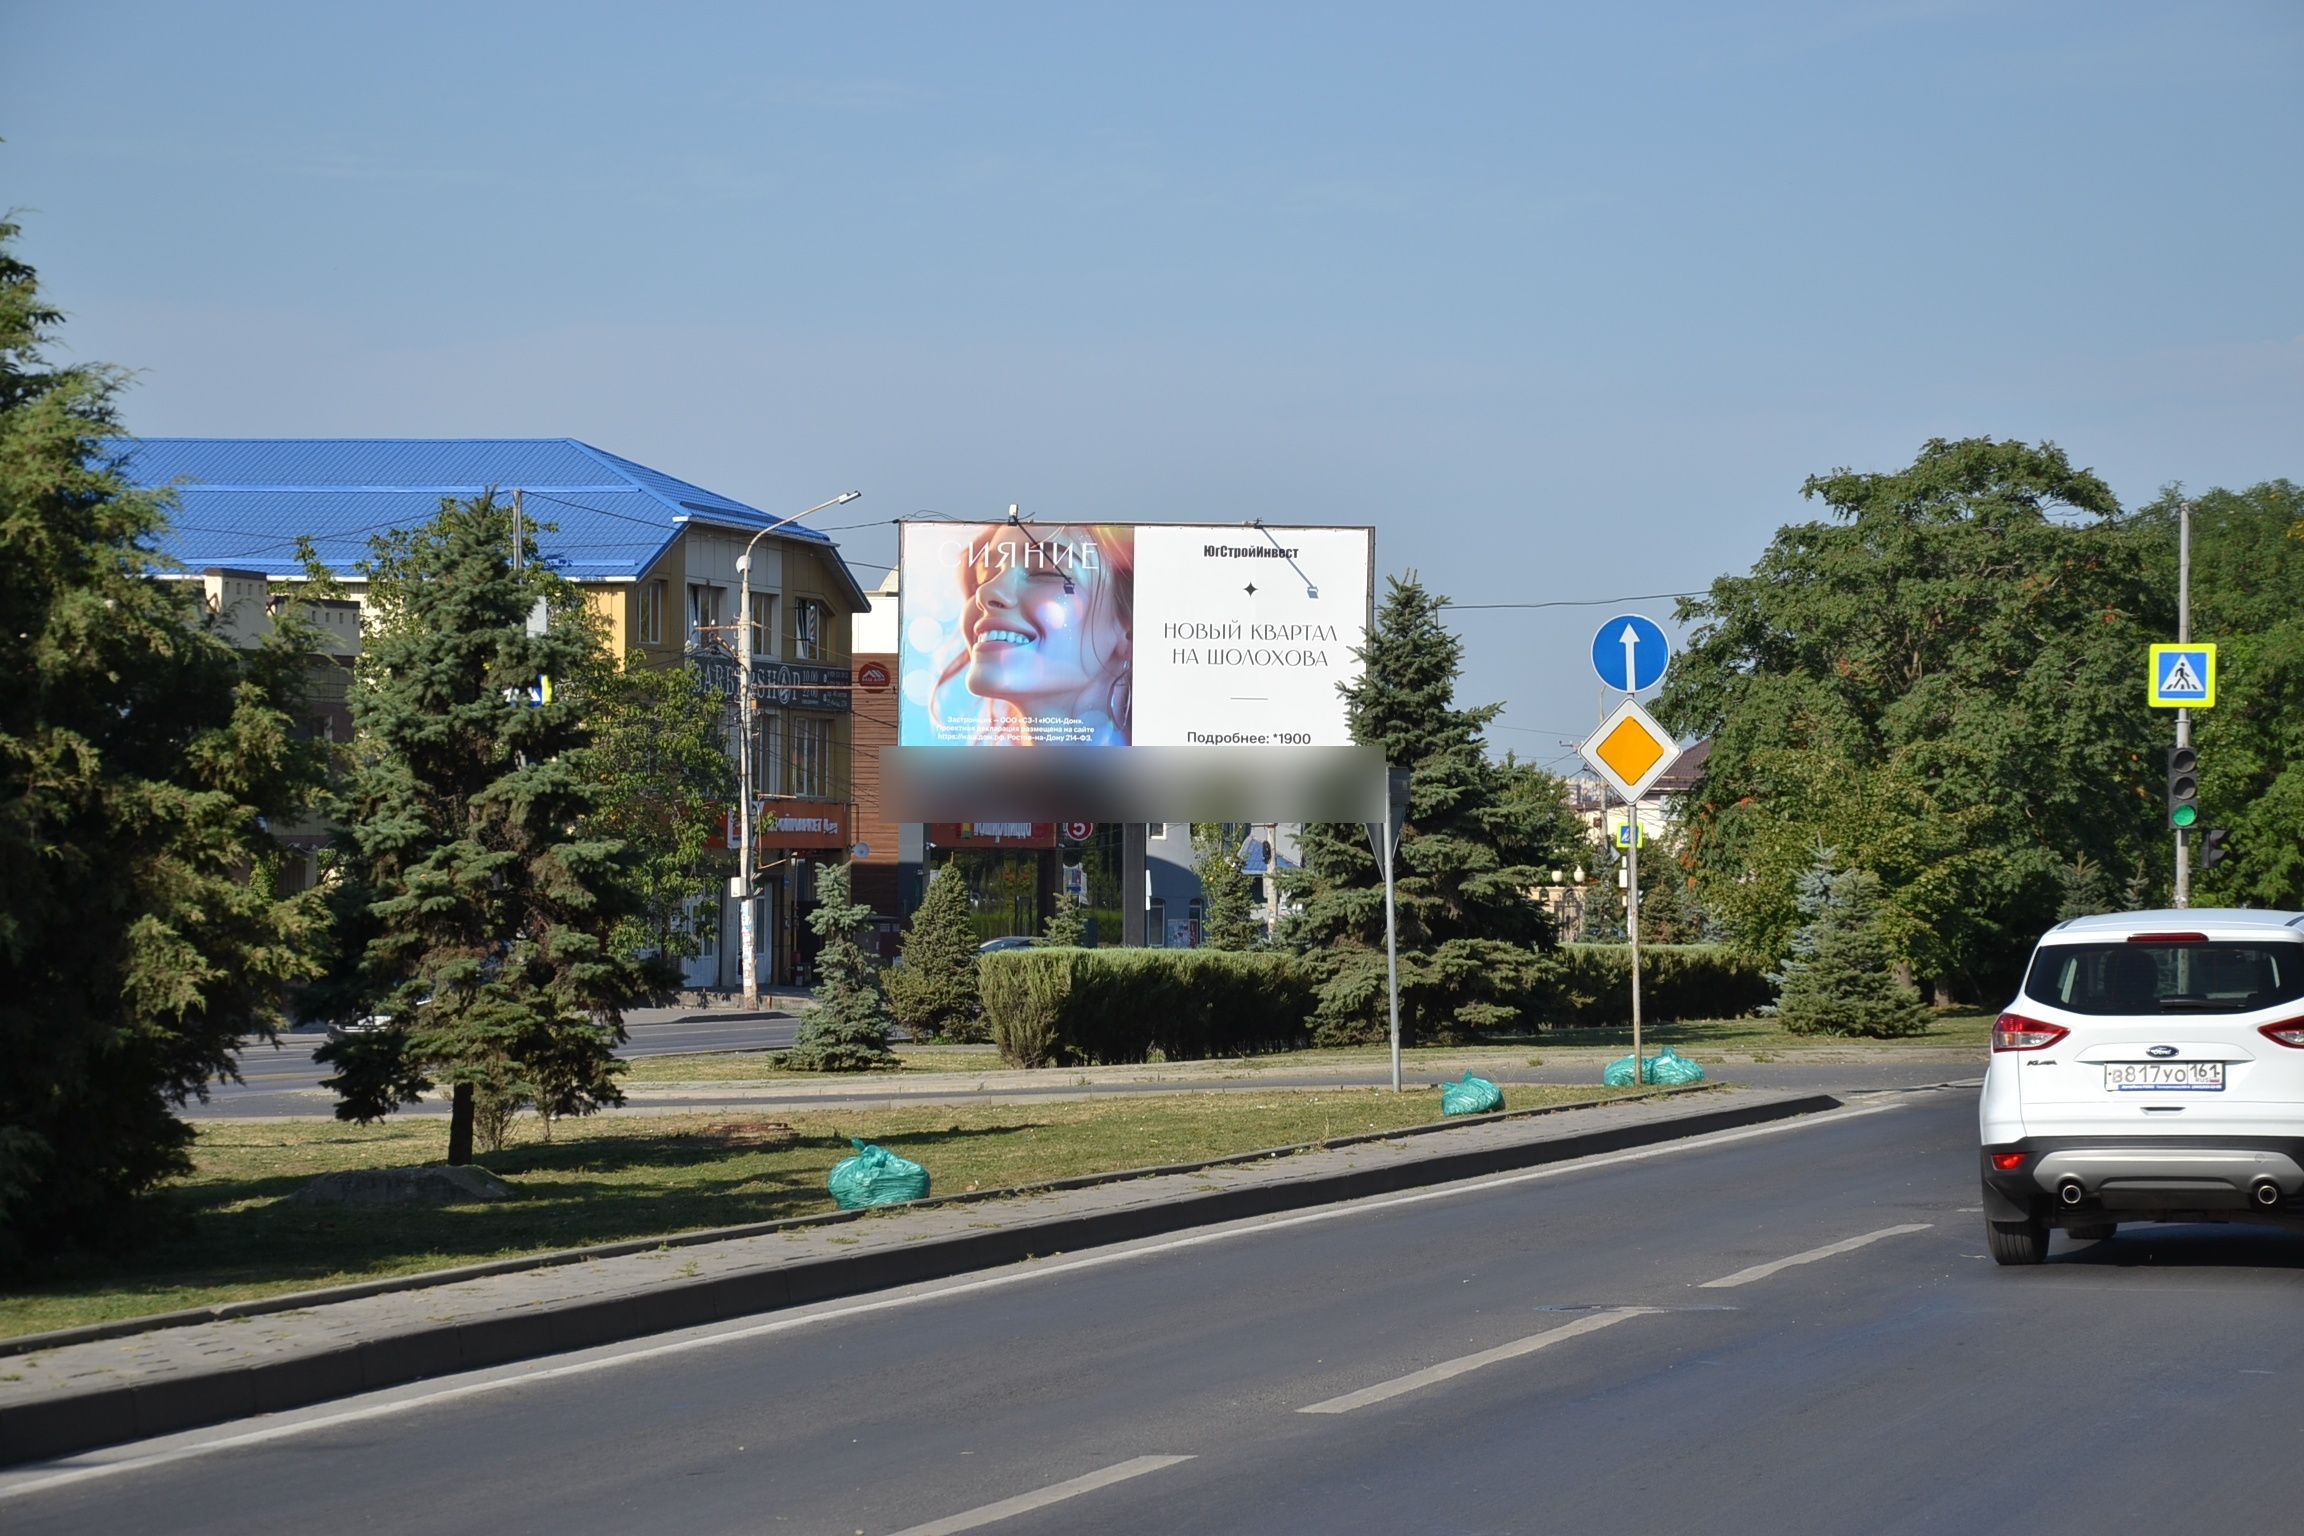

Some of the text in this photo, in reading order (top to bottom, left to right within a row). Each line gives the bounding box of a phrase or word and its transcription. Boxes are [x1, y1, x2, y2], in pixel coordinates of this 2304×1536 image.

[938, 541, 1099, 569] СИЯНИЕ
[1203, 545, 1299, 559] ЮгСтройИнвест
[1164, 619, 1338, 642] НОВЫЙ КВАРТАЛ
[1172, 648, 1329, 667] НА ШОЛОХОВА
[947, 715, 993, 724] Застройщик
[1000, 716, 1018, 724] ООО
[936, 724, 976, 732] Проектная
[1007, 734, 1065, 742] Ростов-на-Дону
[1187, 731, 1270, 746] Подробнее:
[2189, 1063, 2217, 1078] 161
